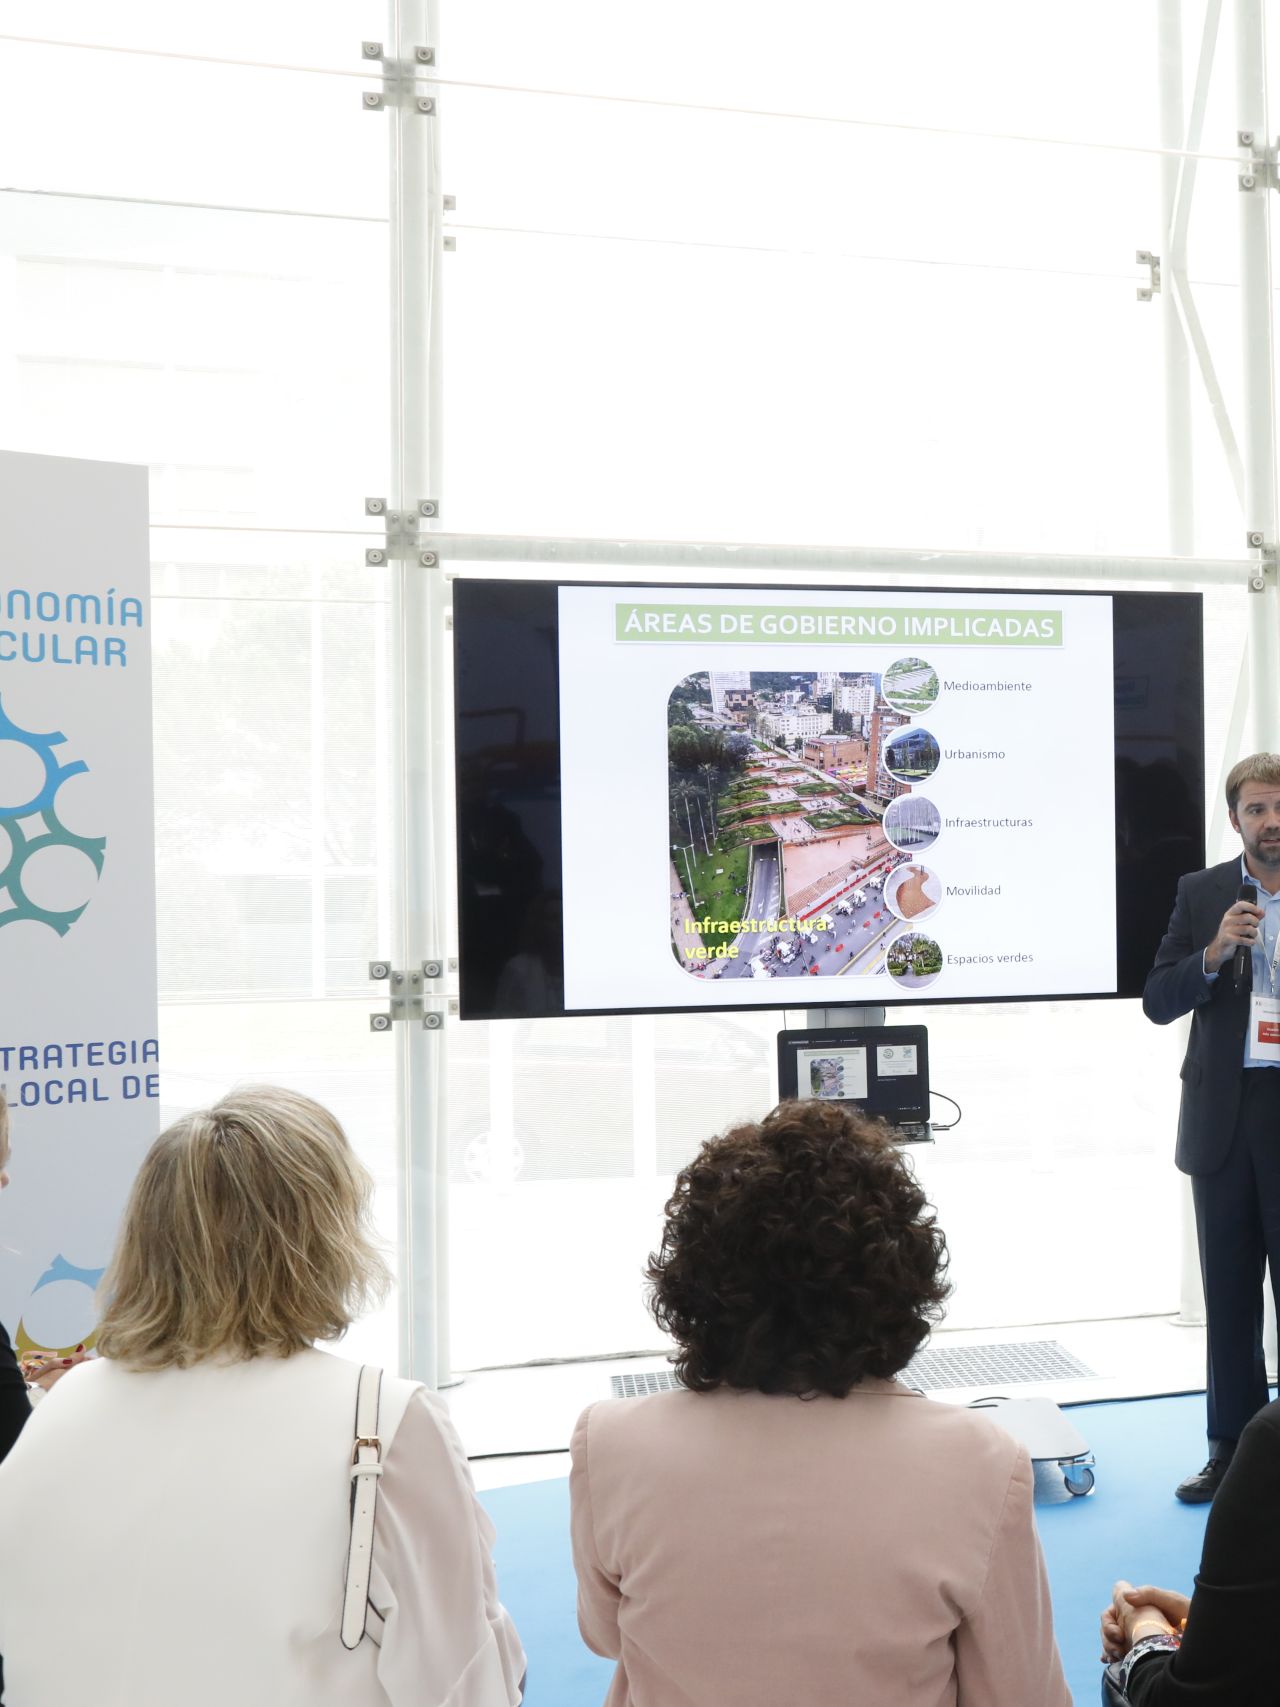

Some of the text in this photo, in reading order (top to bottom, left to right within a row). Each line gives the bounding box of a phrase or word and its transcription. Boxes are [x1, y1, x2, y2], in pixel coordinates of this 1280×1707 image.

[0, 587, 143, 627] NOMÍA
[624, 608, 1054, 638] ÁREAS DE GOBIERNO IMPLICADAS
[943, 680, 1033, 692] Medioambiente
[944, 749, 1006, 760] Urbanismo
[944, 816, 1034, 828] Infraestructuras
[946, 885, 1001, 897] Movilidad
[684, 916, 828, 935] Infraestructura
[685, 942, 739, 960] verde
[946, 951, 1034, 967] Espacios verdes
[2, 1074, 160, 1107] OCAL DE
